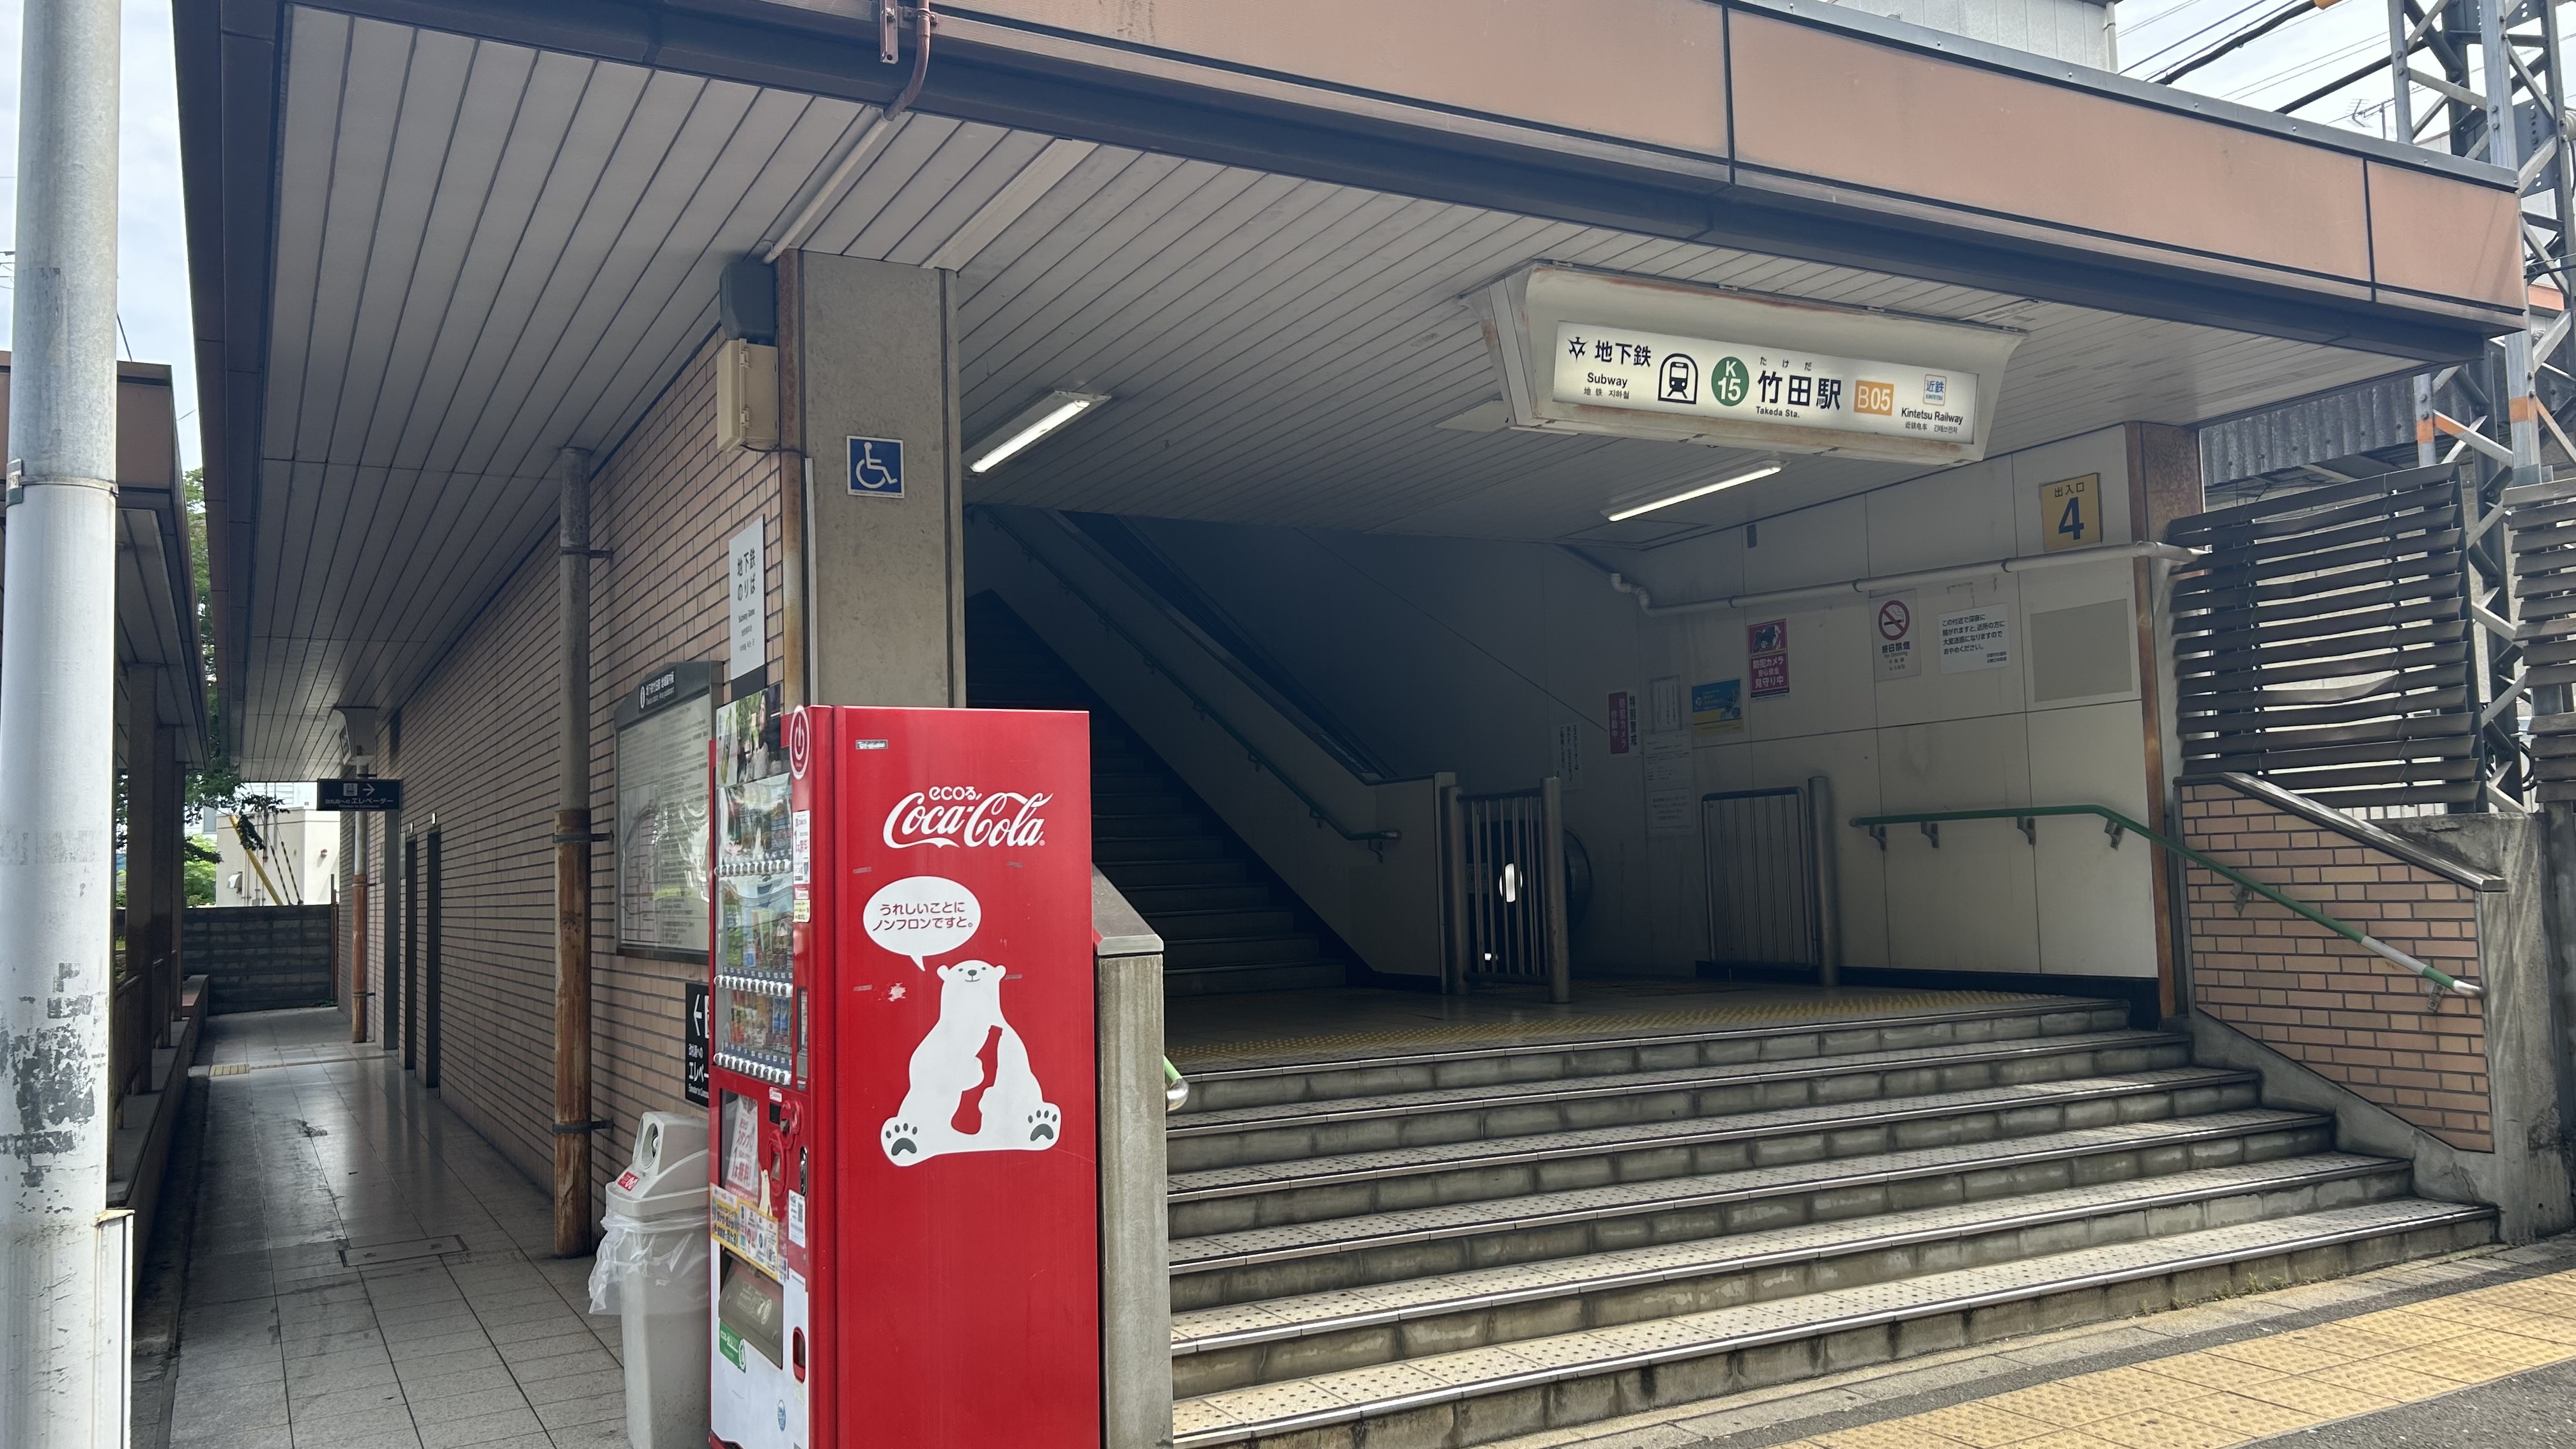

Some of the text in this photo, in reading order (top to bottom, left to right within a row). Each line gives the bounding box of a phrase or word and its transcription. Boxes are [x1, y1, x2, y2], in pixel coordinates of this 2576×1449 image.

[1595, 339, 1651, 367] 地下鉄
[1726, 361, 1736, 377] K
[1759, 356, 1812, 371] たけだ
[1587, 372, 1628, 388] Subway
[1926, 380, 1944, 393] 近鉄
[1609, 390, 1629, 399] 지하철
[1718, 378, 1741, 401] 15
[1758, 371, 1841, 410] 竹田駅
[1857, 386, 1890, 411] B05
[1756, 406, 1800, 418] Takeda Sta.
[1901, 408, 1963, 425] Kintetsu Railway
[2055, 482, 2084, 498] 出入口
[2058, 496, 2084, 540] 4
[737, 547, 755, 577] 地下鉄
[737, 572, 755, 601] のりば
[1942, 614, 1986, 627] この付近で深夜に
[1882, 641, 1910, 654] 終日禁煙
[1943, 644, 1984, 655] おやめください。
[1753, 656, 1784, 670] 防犯カメラ
[1758, 667, 1779, 677] 安心安全
[1755, 675, 1784, 688] 見守り中
[883, 792, 1054, 848] Coca-Cola
[880, 901, 965, 916] うれしいことに
[873, 917, 972, 931] ノンフロンですと。
